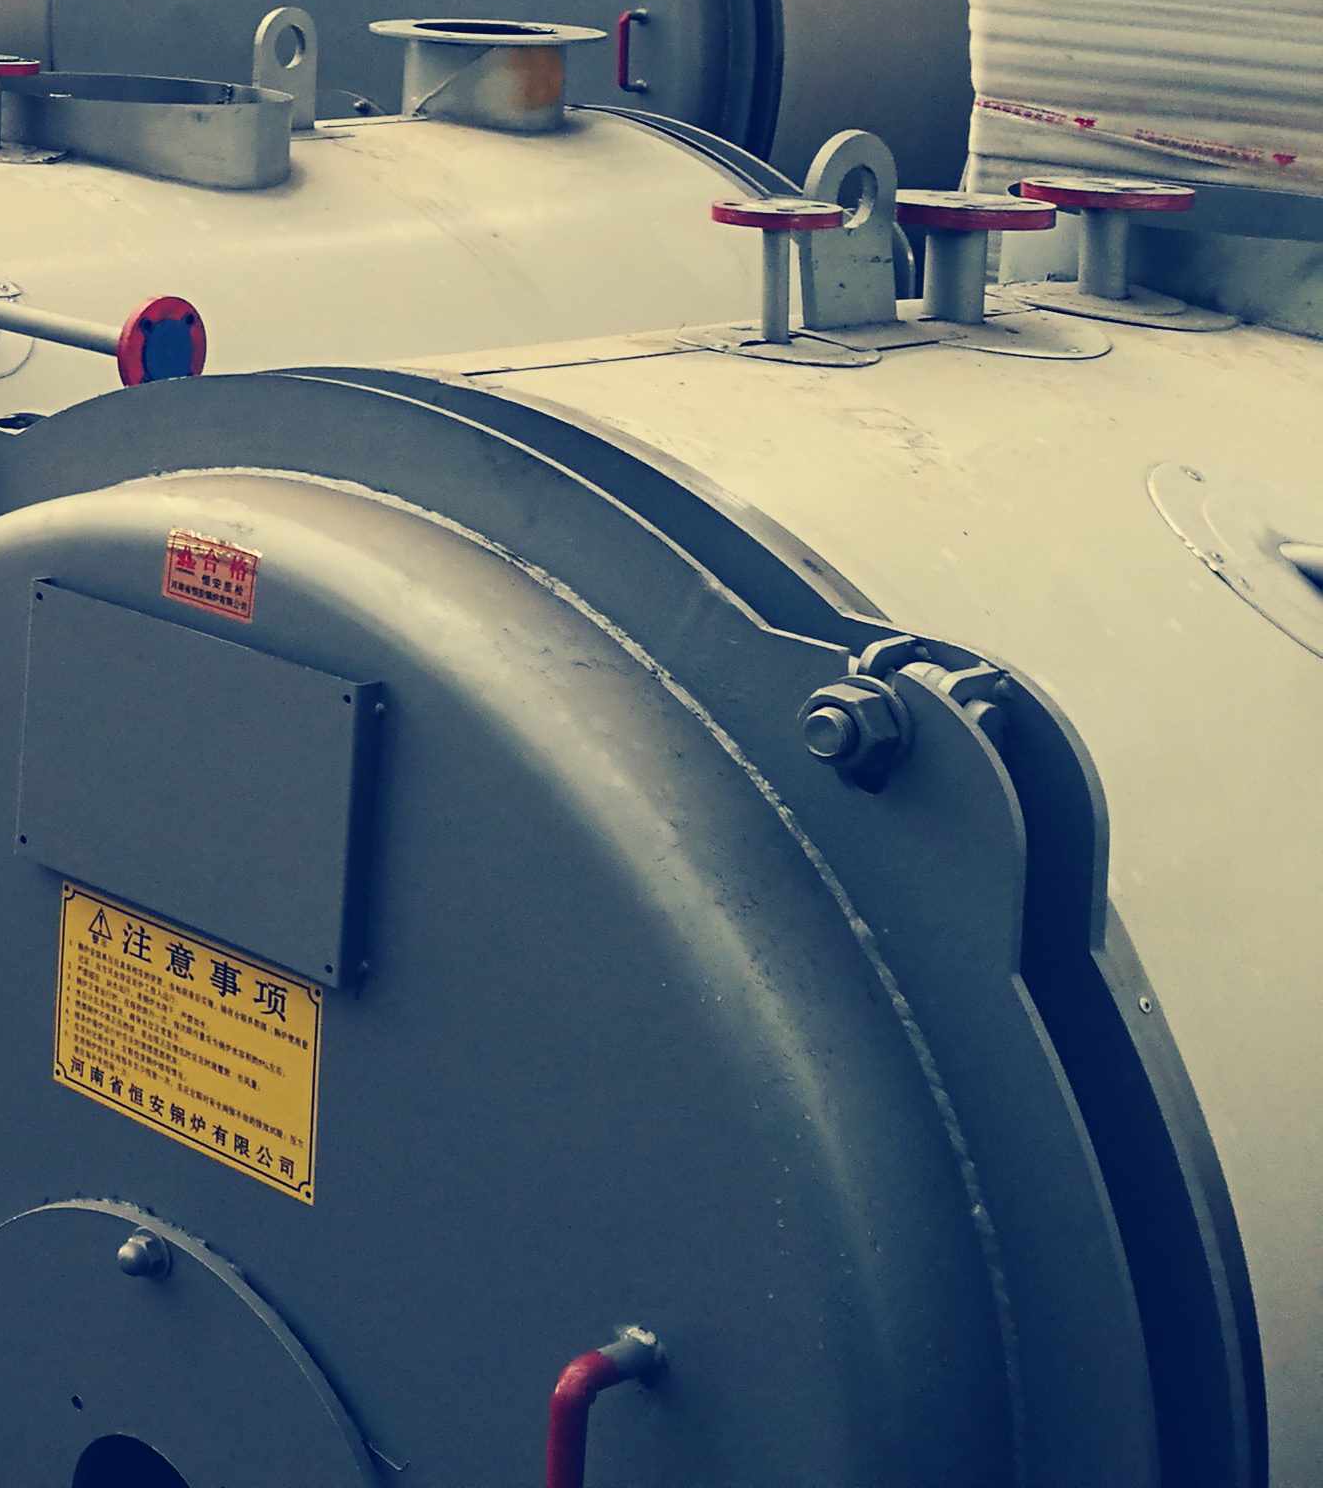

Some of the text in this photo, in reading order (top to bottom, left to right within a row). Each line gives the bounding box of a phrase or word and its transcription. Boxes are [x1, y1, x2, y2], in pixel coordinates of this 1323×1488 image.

[203, 548, 248, 581] 合格
[121, 921, 289, 1023] 注意事项
[69, 1054, 296, 1180] 河南省恒安锅炉有限公司
